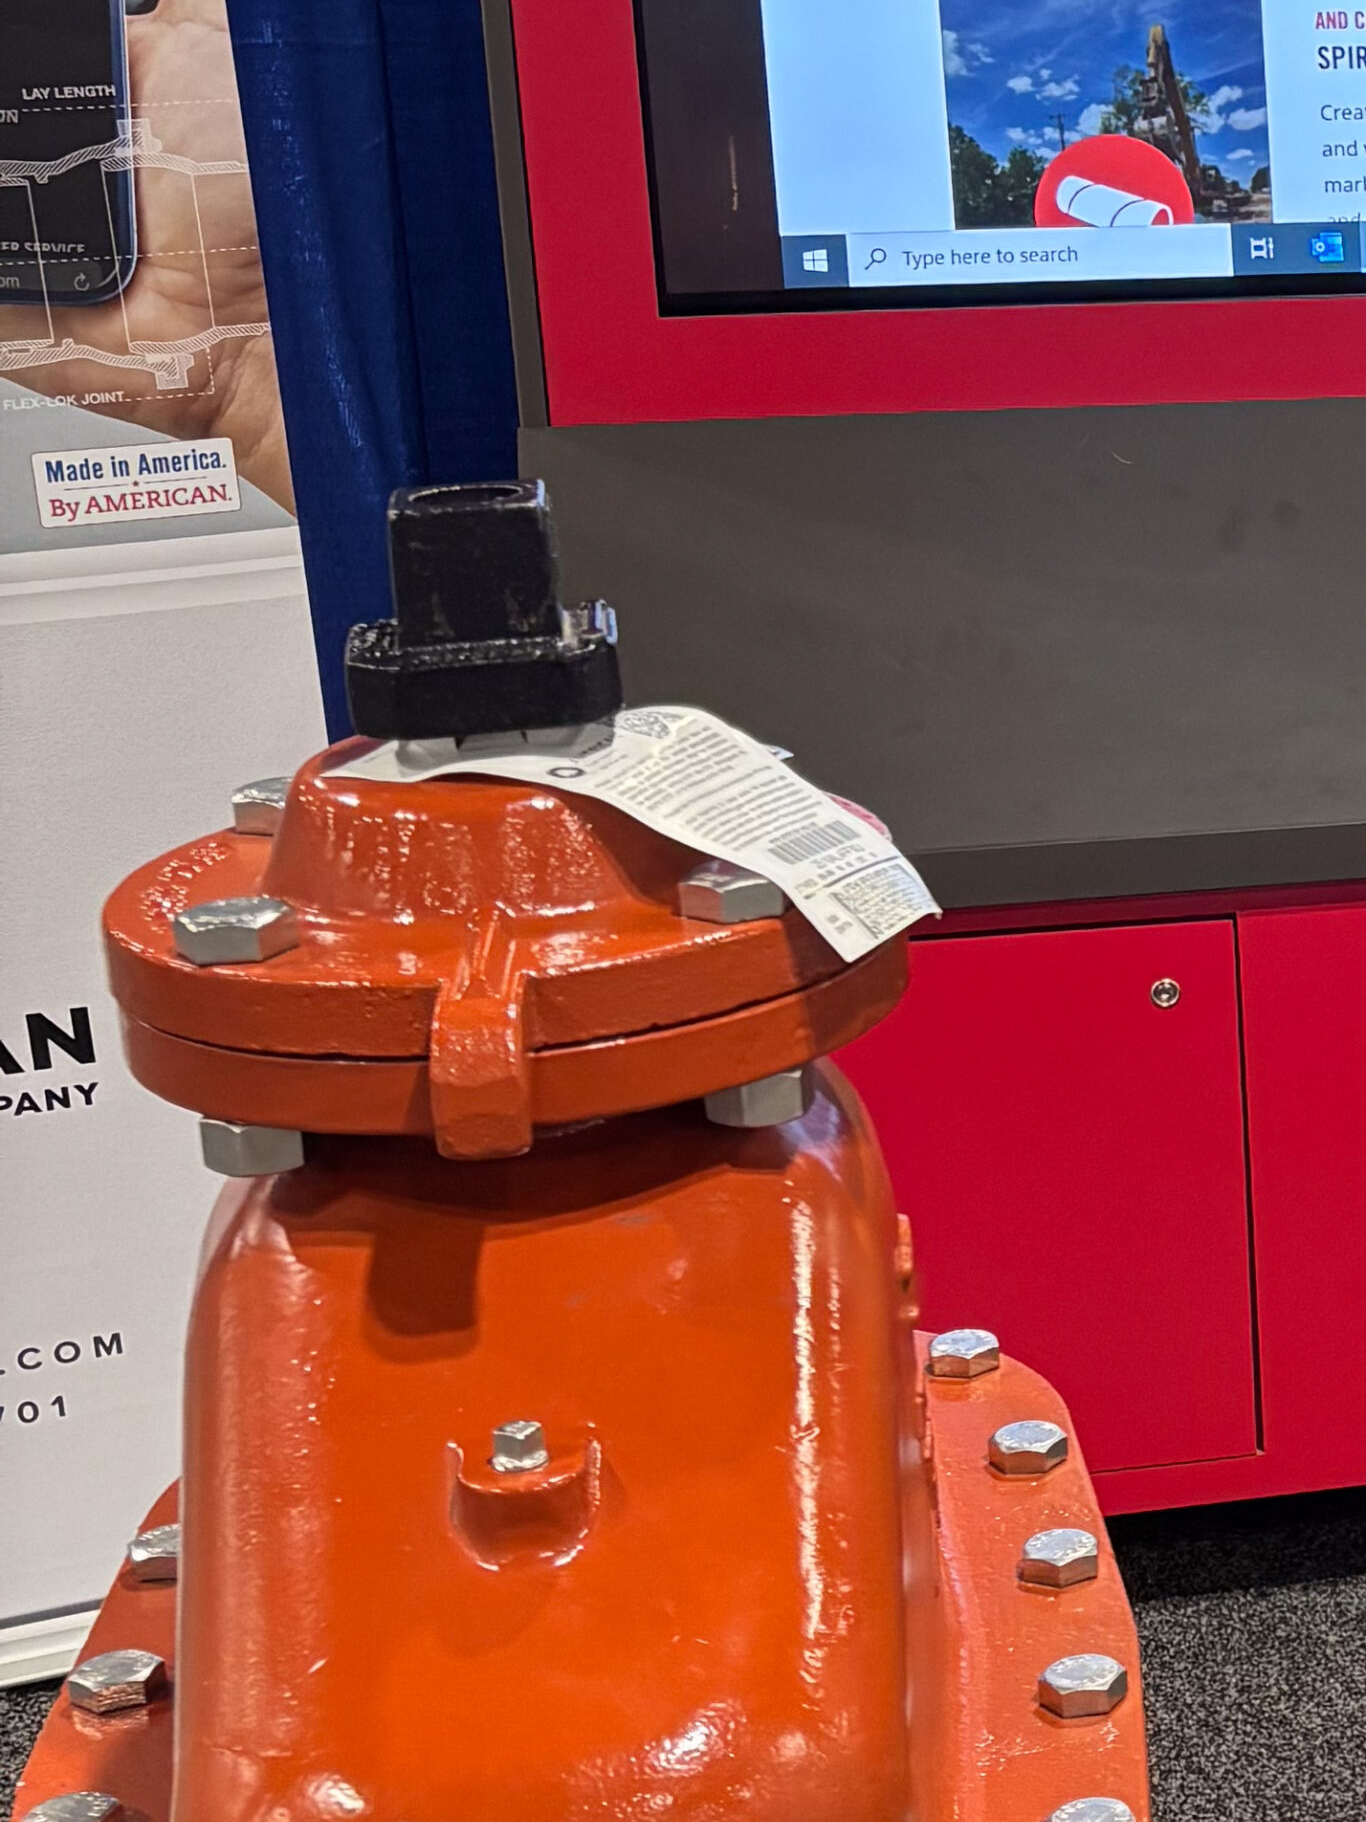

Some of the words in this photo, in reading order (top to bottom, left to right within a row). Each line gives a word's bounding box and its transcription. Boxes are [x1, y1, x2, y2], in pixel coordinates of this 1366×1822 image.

[1316, 11, 1348, 30] AND
[22, 88, 51, 101] LAY
[54, 84, 117, 99] LENGTH
[1323, 139, 1358, 157] and
[902, 251, 944, 270] Type
[951, 249, 990, 265] here
[997, 248, 1014, 264] to
[1020, 245, 1078, 263] search
[81, 391, 126, 405] JOINT
[45, 458, 104, 484] Made
[110, 455, 130, 478] in
[138, 448, 227, 476] America.
[49, 498, 80, 522] By
[84, 483, 232, 515] AMERICAN.
